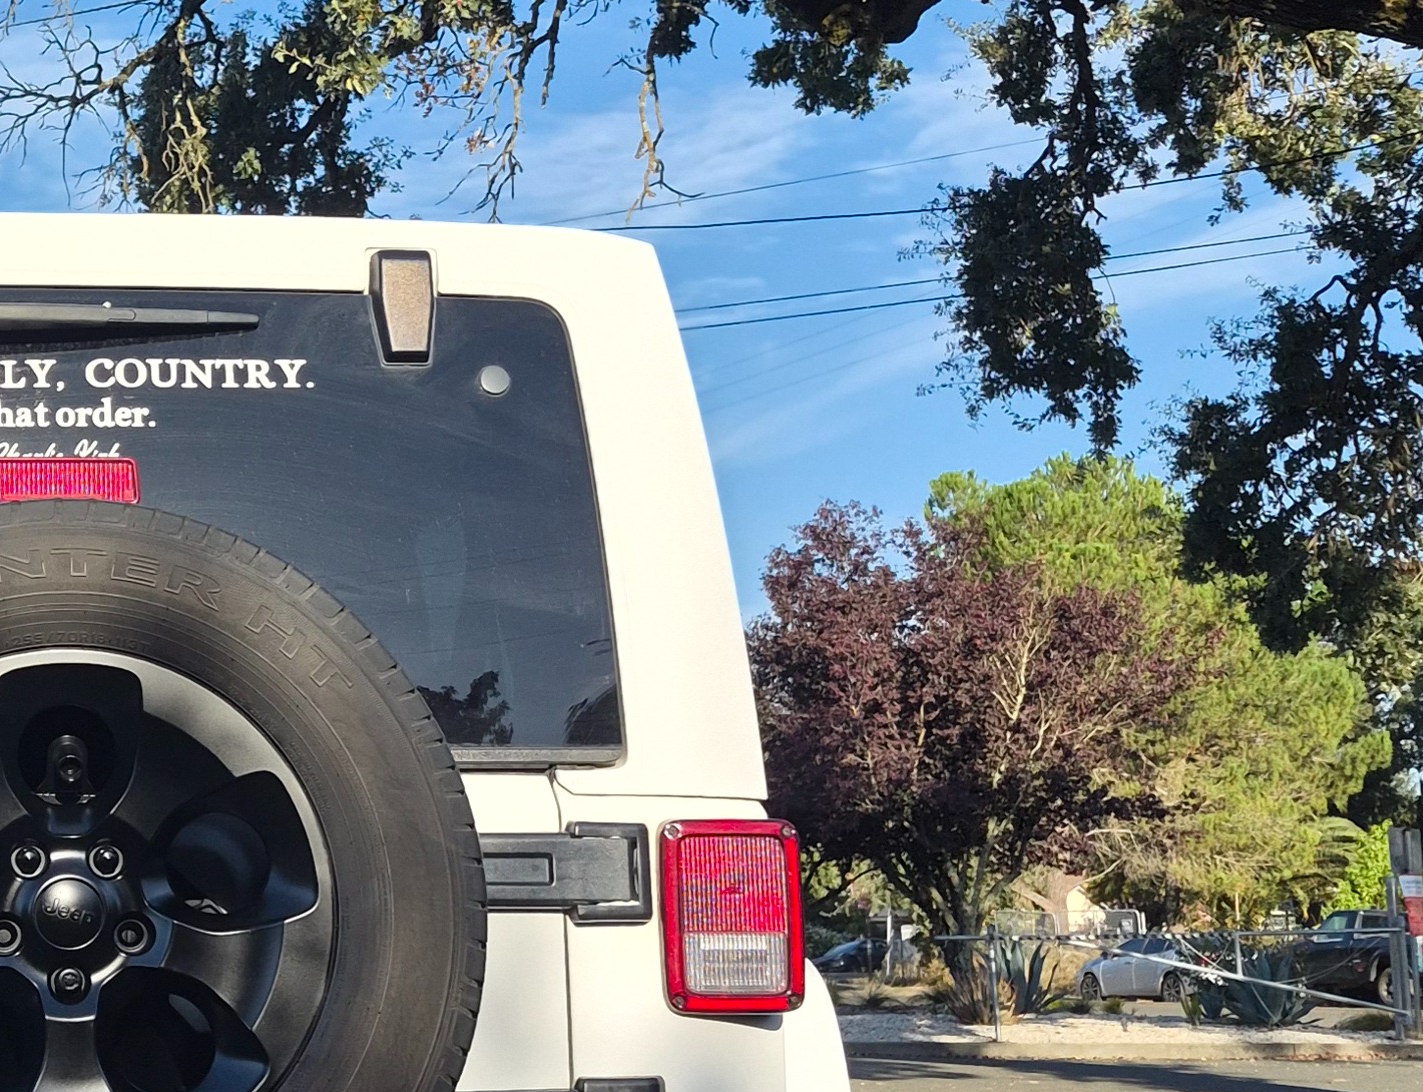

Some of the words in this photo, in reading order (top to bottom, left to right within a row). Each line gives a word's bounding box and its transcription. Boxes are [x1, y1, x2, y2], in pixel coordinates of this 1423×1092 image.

[84, 358, 315, 389] COUNTRY.
[54, 397, 157, 428] order.
[244, 604, 353, 687] HT
[42, 898, 95, 924] Jeep
